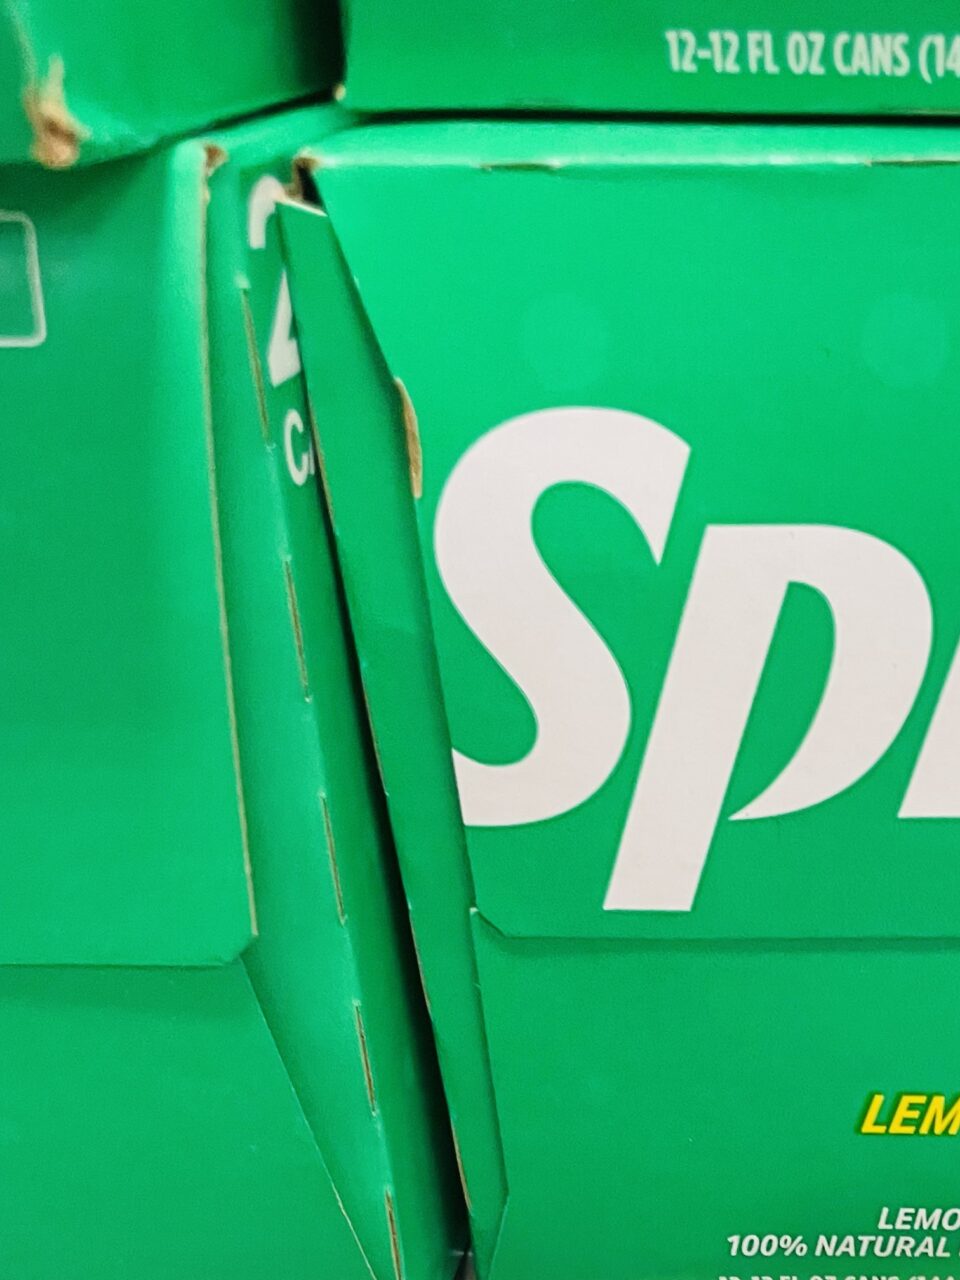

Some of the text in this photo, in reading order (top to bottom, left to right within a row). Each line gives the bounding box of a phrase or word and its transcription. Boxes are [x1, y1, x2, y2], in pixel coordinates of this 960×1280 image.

[665, 29, 741, 73] 12-12
[746, 30, 780, 74] FL
[786, 31, 826, 75] OZ
[832, 32, 910, 77] CANS
[726, 1233, 809, 1257] 100%
[814, 1234, 951, 1258] NATURAL
